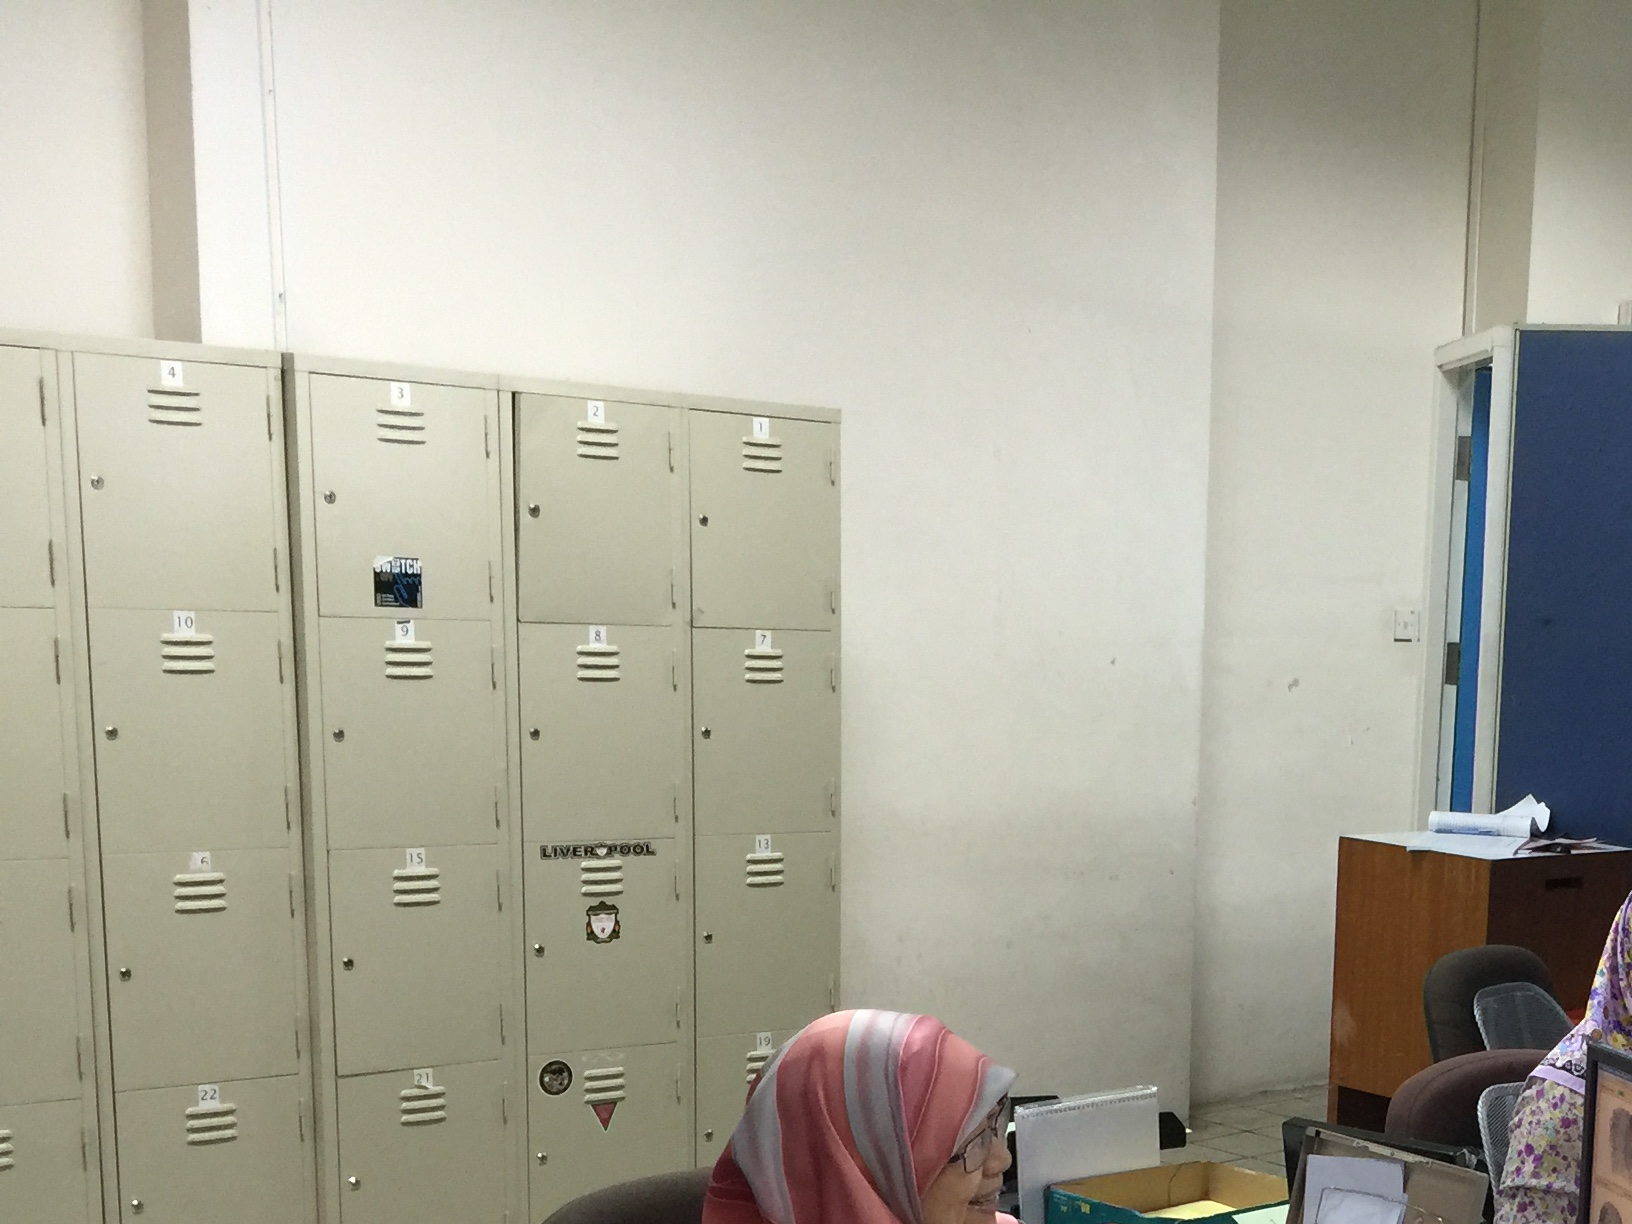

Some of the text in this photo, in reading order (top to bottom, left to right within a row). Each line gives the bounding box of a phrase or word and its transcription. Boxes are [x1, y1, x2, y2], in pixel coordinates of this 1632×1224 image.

[167, 366, 177, 379] 4
[396, 387, 405, 399] 3
[592, 405, 599, 417] 2
[757, 421, 763, 433] 1
[176, 615, 194, 630] 10
[400, 625, 409, 637] 9
[594, 629, 602, 642] 8
[760, 633, 767, 645] 7
[757, 838, 770, 850] 13
[541, 842, 657, 860] LIVERPOOL
[408, 851, 424, 865] 15
[757, 1036, 771, 1048] 19
[416, 1072, 429, 1085] 21
[200, 1087, 218, 1102] 22
